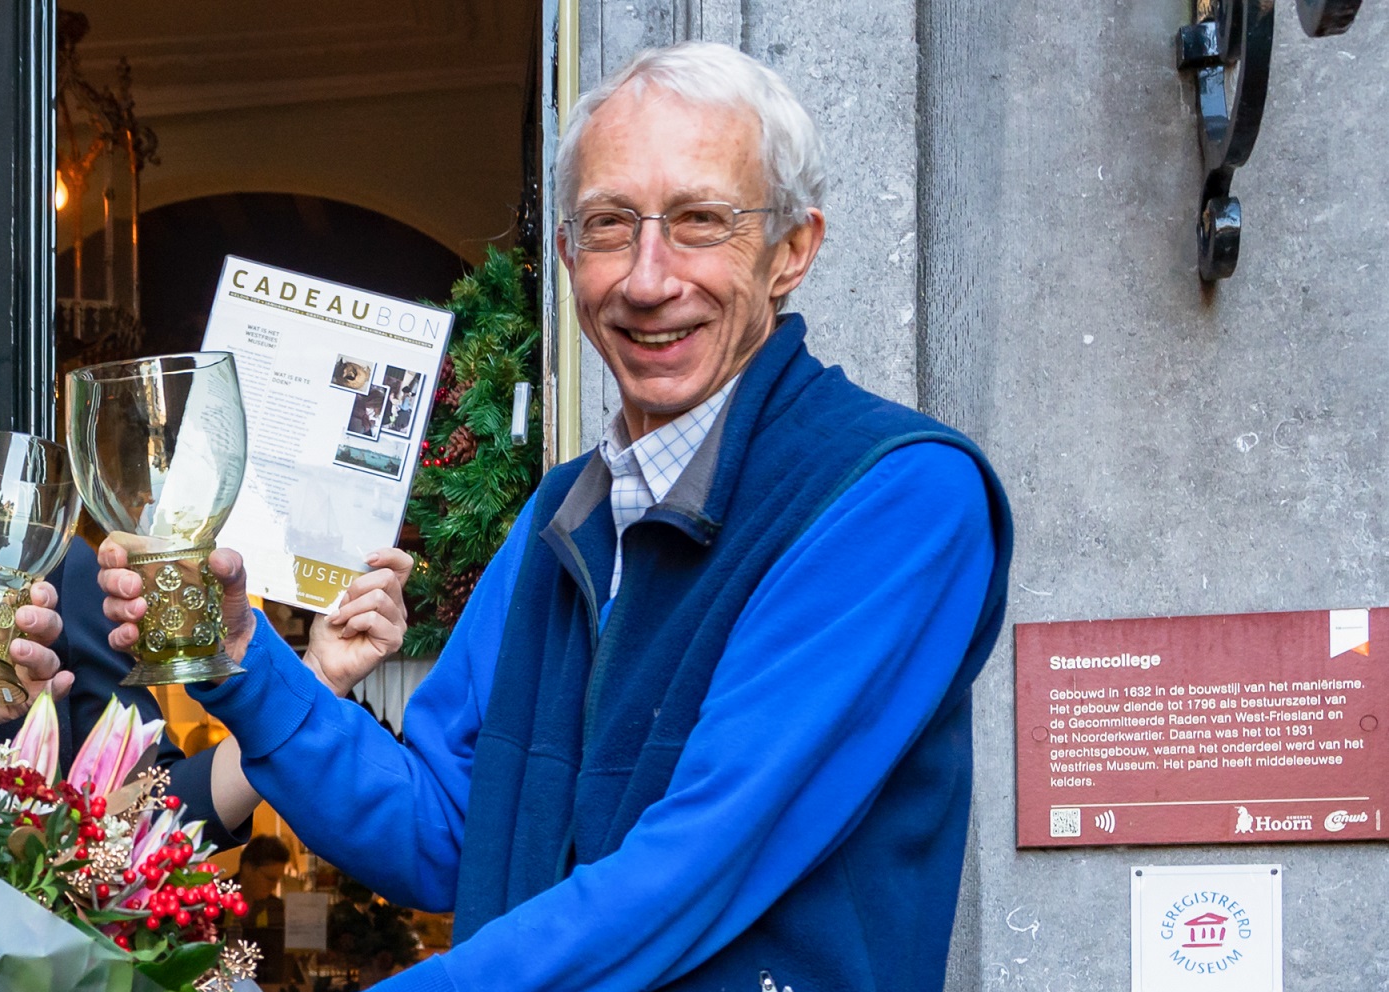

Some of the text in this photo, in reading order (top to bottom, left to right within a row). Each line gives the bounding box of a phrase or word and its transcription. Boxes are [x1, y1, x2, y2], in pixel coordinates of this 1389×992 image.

[1049, 653, 1162, 670] Statencollege
[1049, 687, 1106, 701] Gebouwd
[1108, 687, 1120, 698] in
[1123, 685, 1152, 698] 1632
[1155, 685, 1166, 696] in
[1169, 684, 1185, 696] de
[1188, 682, 1241, 696] bouwstijl
[1243, 683, 1266, 693] van
[1268, 681, 1289, 692] het
[1049, 694, 1347, 716] Het gebouw diende tot 1796 als bestuurszetel van
[1049, 709, 1344, 730] de Gecommitteerde Raden van West-Friesland en
[1049, 724, 1313, 744] het Noorderkwartier. Daarna was het tot 1931
[1049, 738, 1364, 761] gerechtsgebouw, waarna het onderdeel werd van het
[1049, 754, 1343, 773] Westfries Museum. Het pand heeft middeleeuwse
[1050, 776, 1096, 788] kelders.
[1255, 815, 1313, 832] Hoorn
[1161, 891, 1252, 940] GEREGISTREERD
[1169, 949, 1244, 975] MUSEUM
